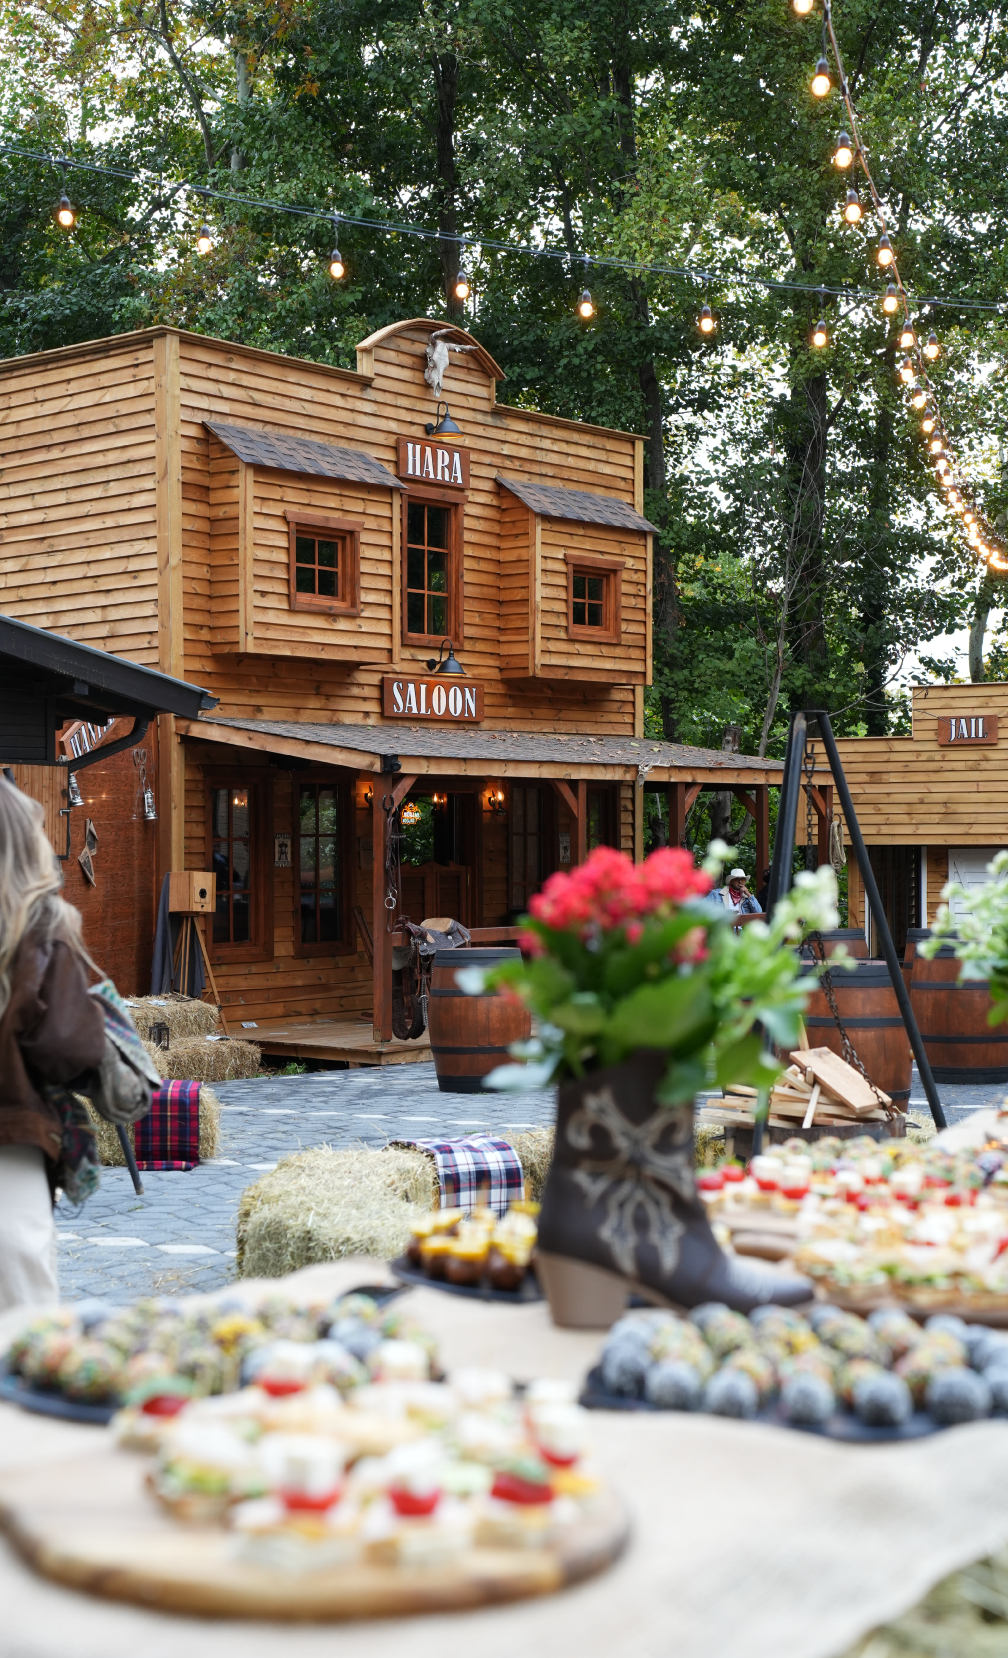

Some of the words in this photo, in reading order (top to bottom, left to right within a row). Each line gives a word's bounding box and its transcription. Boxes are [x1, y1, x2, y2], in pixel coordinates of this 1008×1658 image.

[406, 442, 463, 484] HARA
[392, 681, 477, 718] SALOON
[948, 717, 988, 742] JAIL
